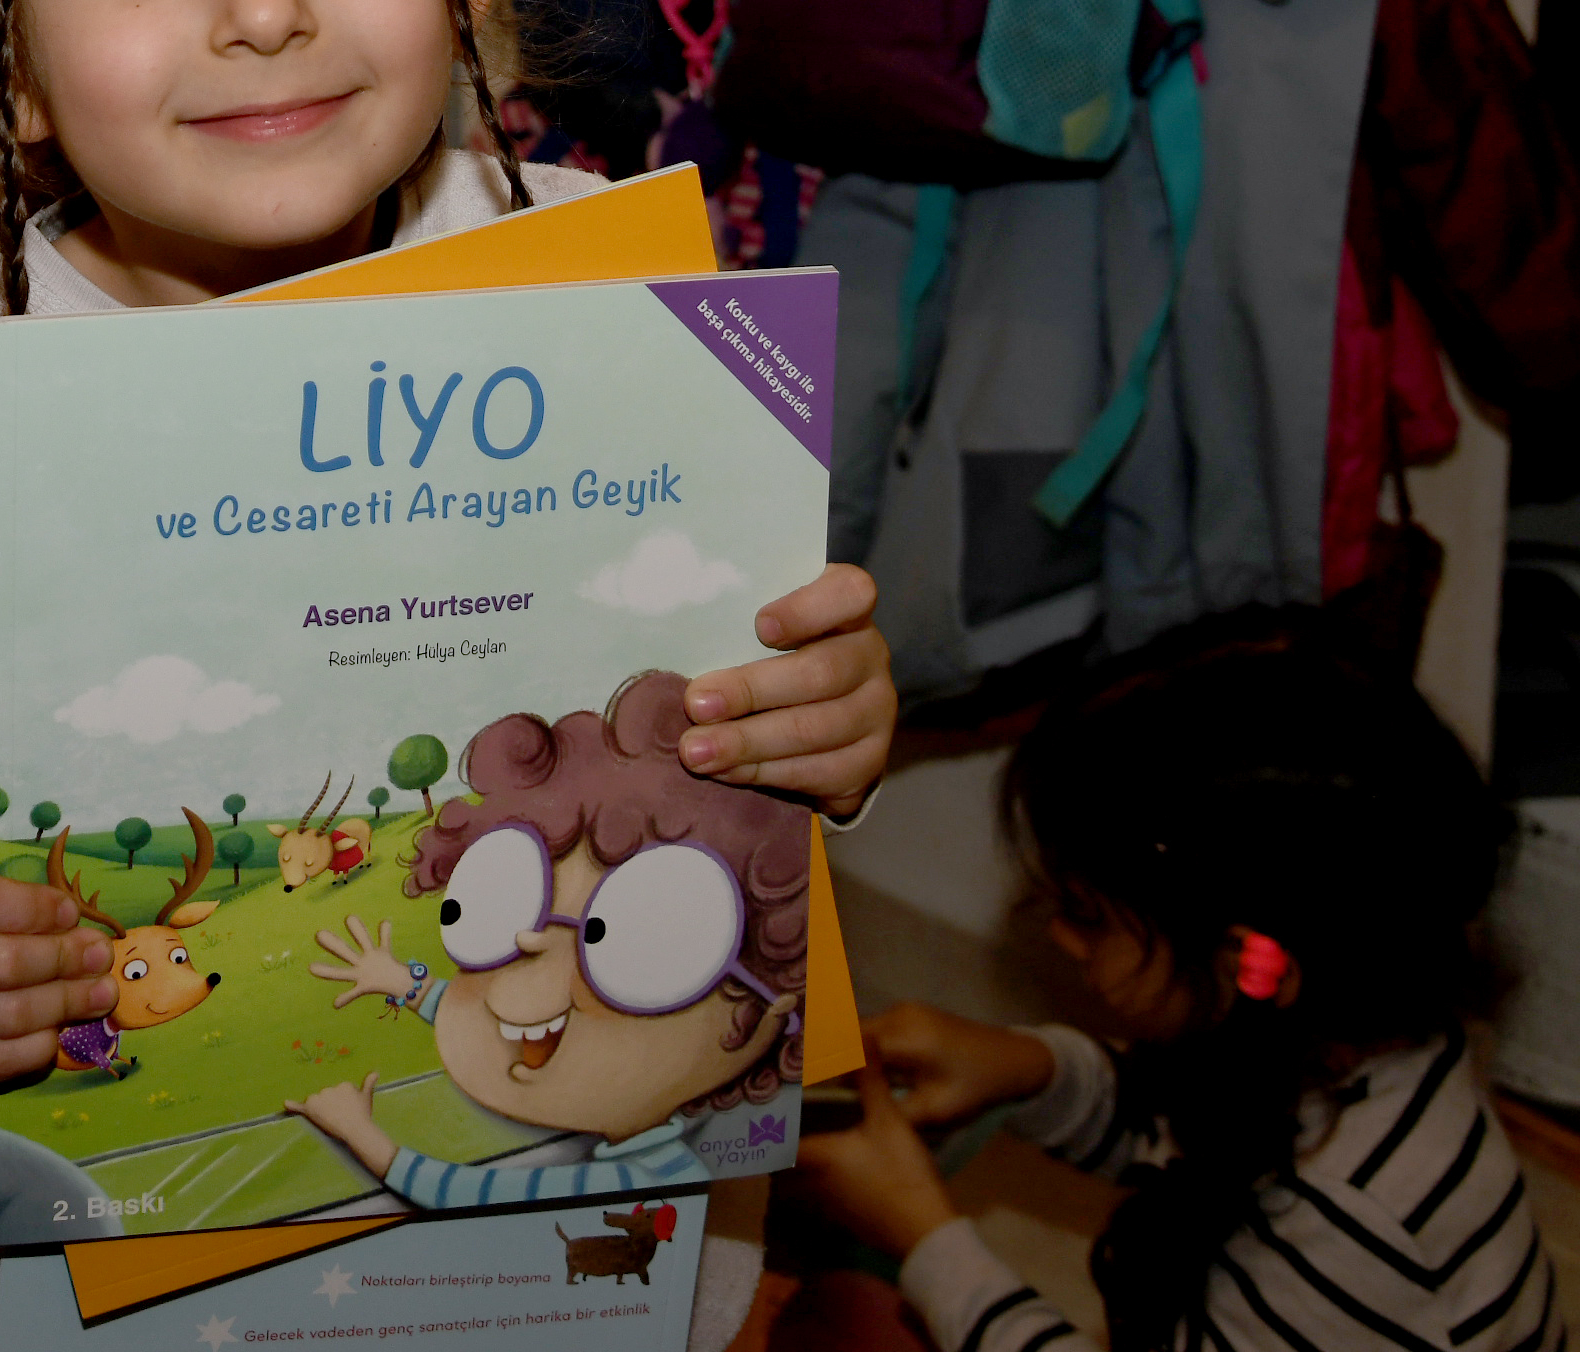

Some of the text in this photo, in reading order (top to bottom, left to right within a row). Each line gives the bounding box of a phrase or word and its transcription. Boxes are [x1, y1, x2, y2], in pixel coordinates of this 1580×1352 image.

[696, 299, 813, 423] başa çıkma hikayesidir.
[725, 298, 815, 395] Korku ve kaygı ile
[299, 360, 545, 473] LİYO
[156, 463, 682, 539] ve Cesareti Arayan Geyik
[302, 592, 534, 628] Asena Yurtsever
[328, 638, 507, 667] Resimleyen: Hülya Ceylan
[700, 1137, 746, 1154] anya
[53, 1192, 164, 1221] 2. Baskı
[360, 1271, 551, 1288] Noktaları birleştirip boyama
[244, 1301, 651, 1343] Gelecek vadeden genç sanatçılar için harika bir etkinlik
